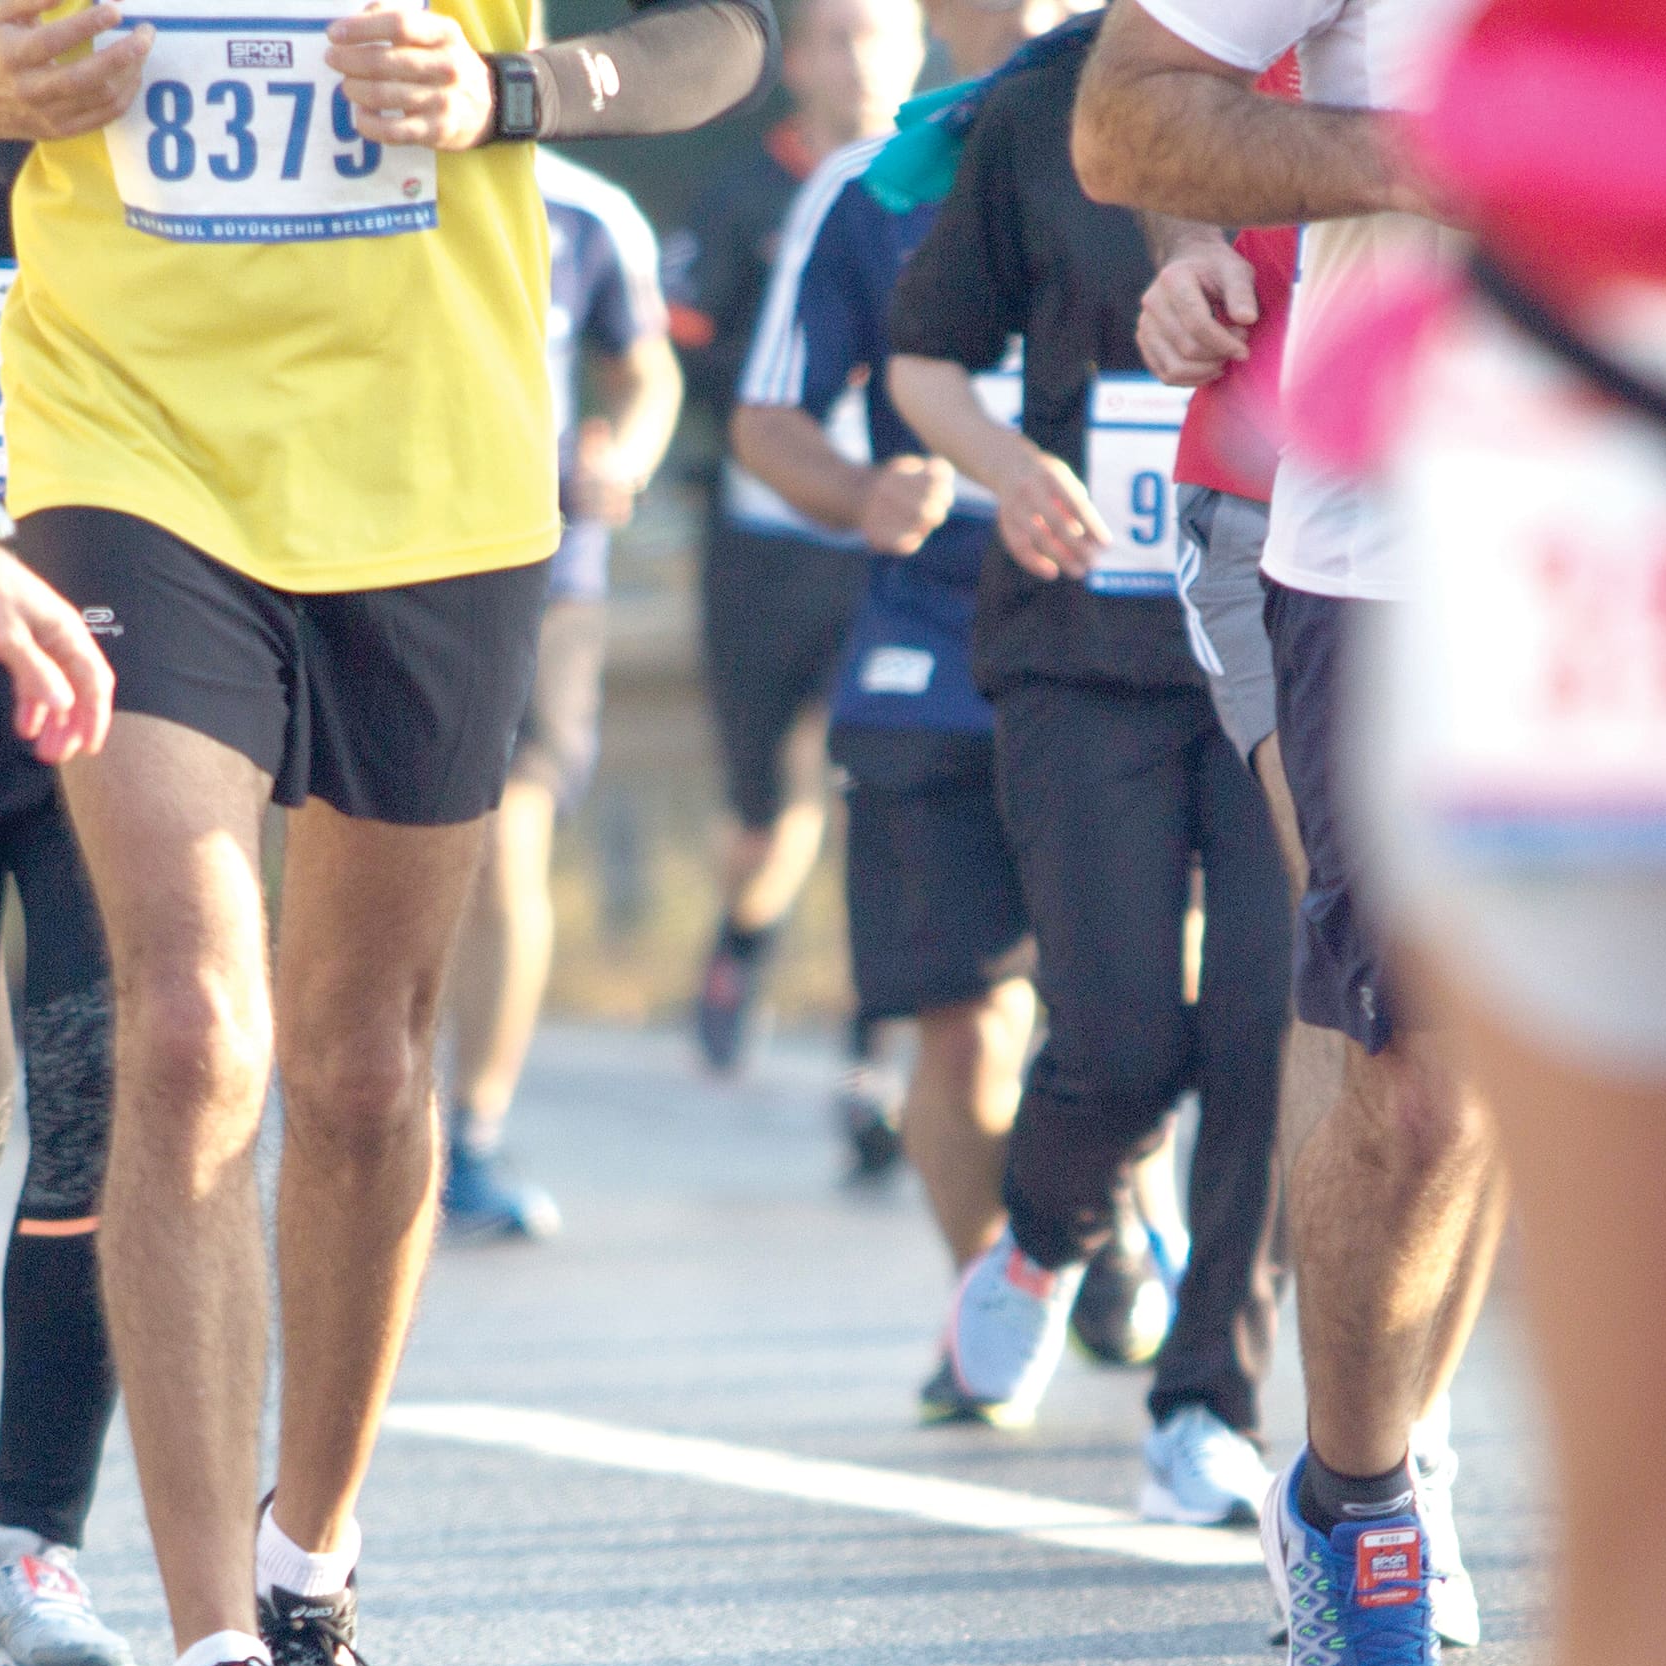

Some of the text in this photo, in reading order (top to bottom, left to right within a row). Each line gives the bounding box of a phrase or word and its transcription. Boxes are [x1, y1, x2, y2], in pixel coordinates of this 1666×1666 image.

[232, 42, 289, 57] SPOR
[145, 79, 382, 182] 8379
[1130, 470, 1166, 546] 9
